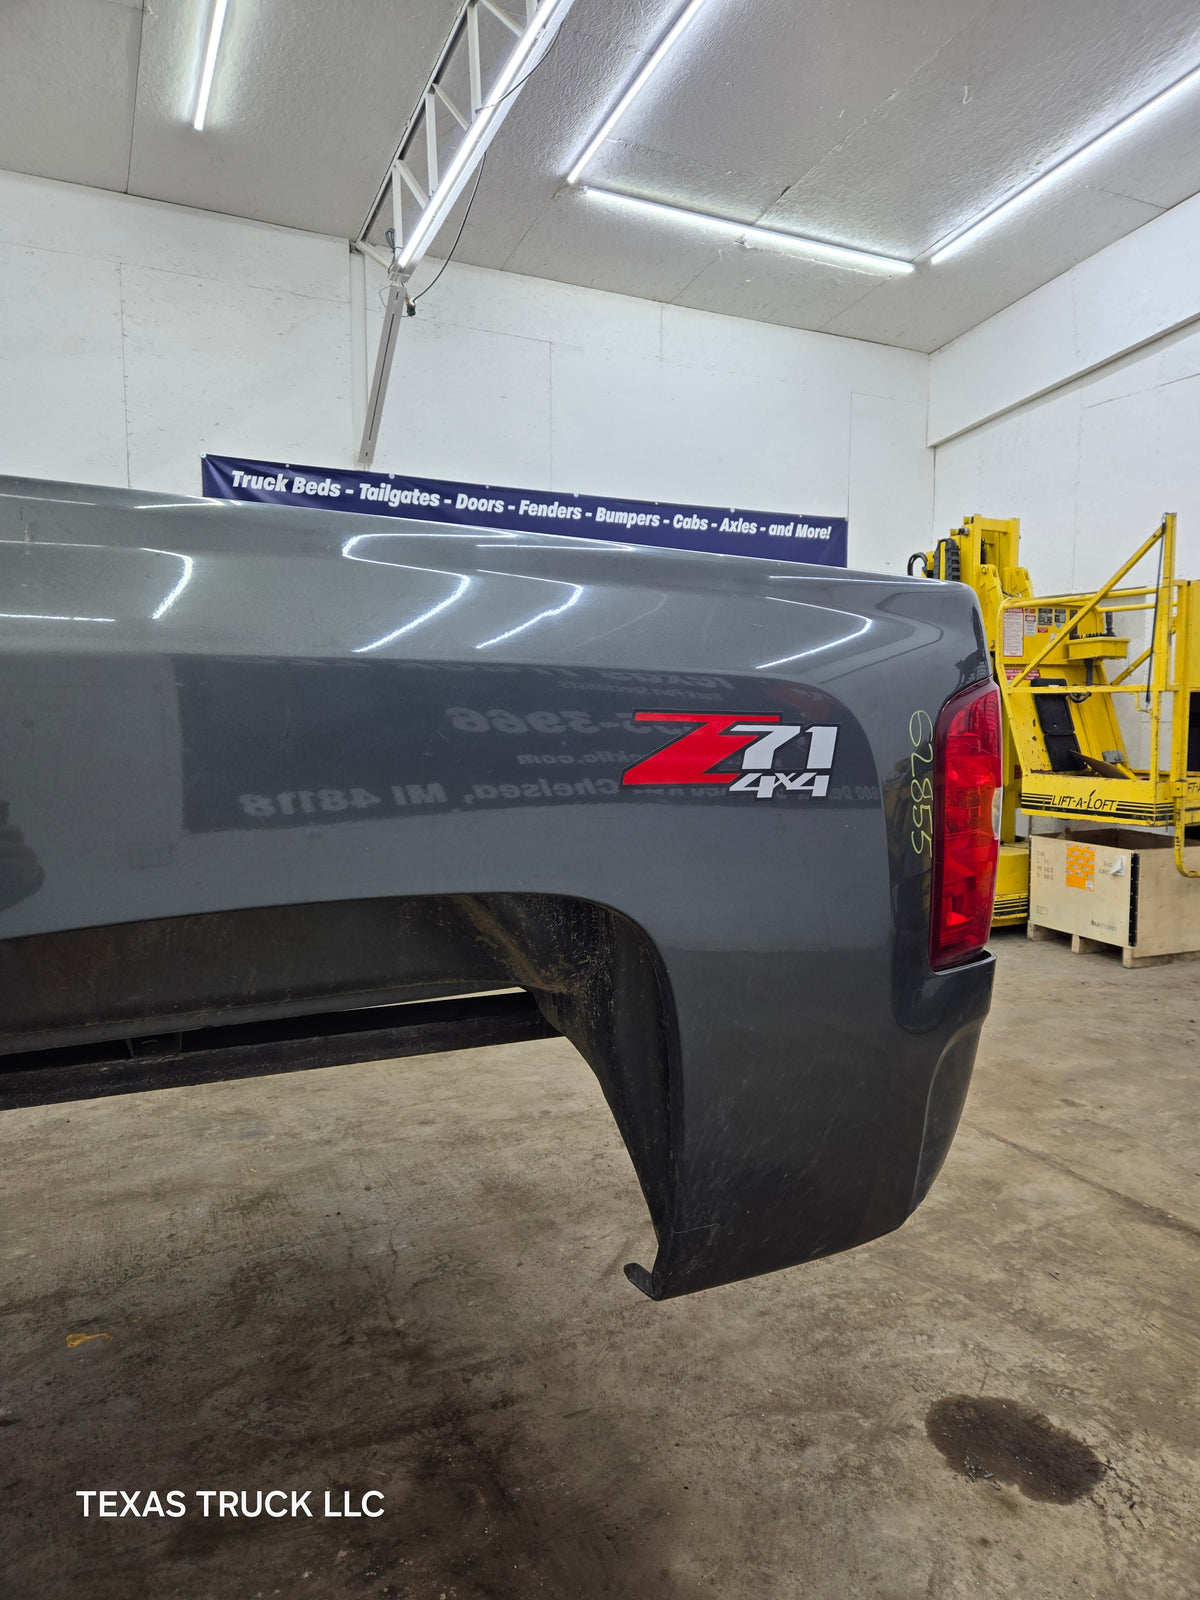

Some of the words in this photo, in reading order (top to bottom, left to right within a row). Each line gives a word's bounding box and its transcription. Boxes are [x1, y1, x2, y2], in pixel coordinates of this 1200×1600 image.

[231, 470, 289, 493] Truck
[291, 476, 342, 497] Beds
[359, 482, 441, 508] Tailgates
[455, 493, 505, 513] Doors
[518, 499, 583, 520] Fenders
[595, 506, 661, 529] Bumpers
[672, 513, 709, 531] Cabs
[718, 517, 758, 535] Axles
[768, 521, 795, 538] and
[794, 523, 832, 540] More!
[622, 712, 838, 785] Z71
[909, 709, 934, 858] 62855
[1051, 789, 1118, 812] LIFT-A-LOFT
